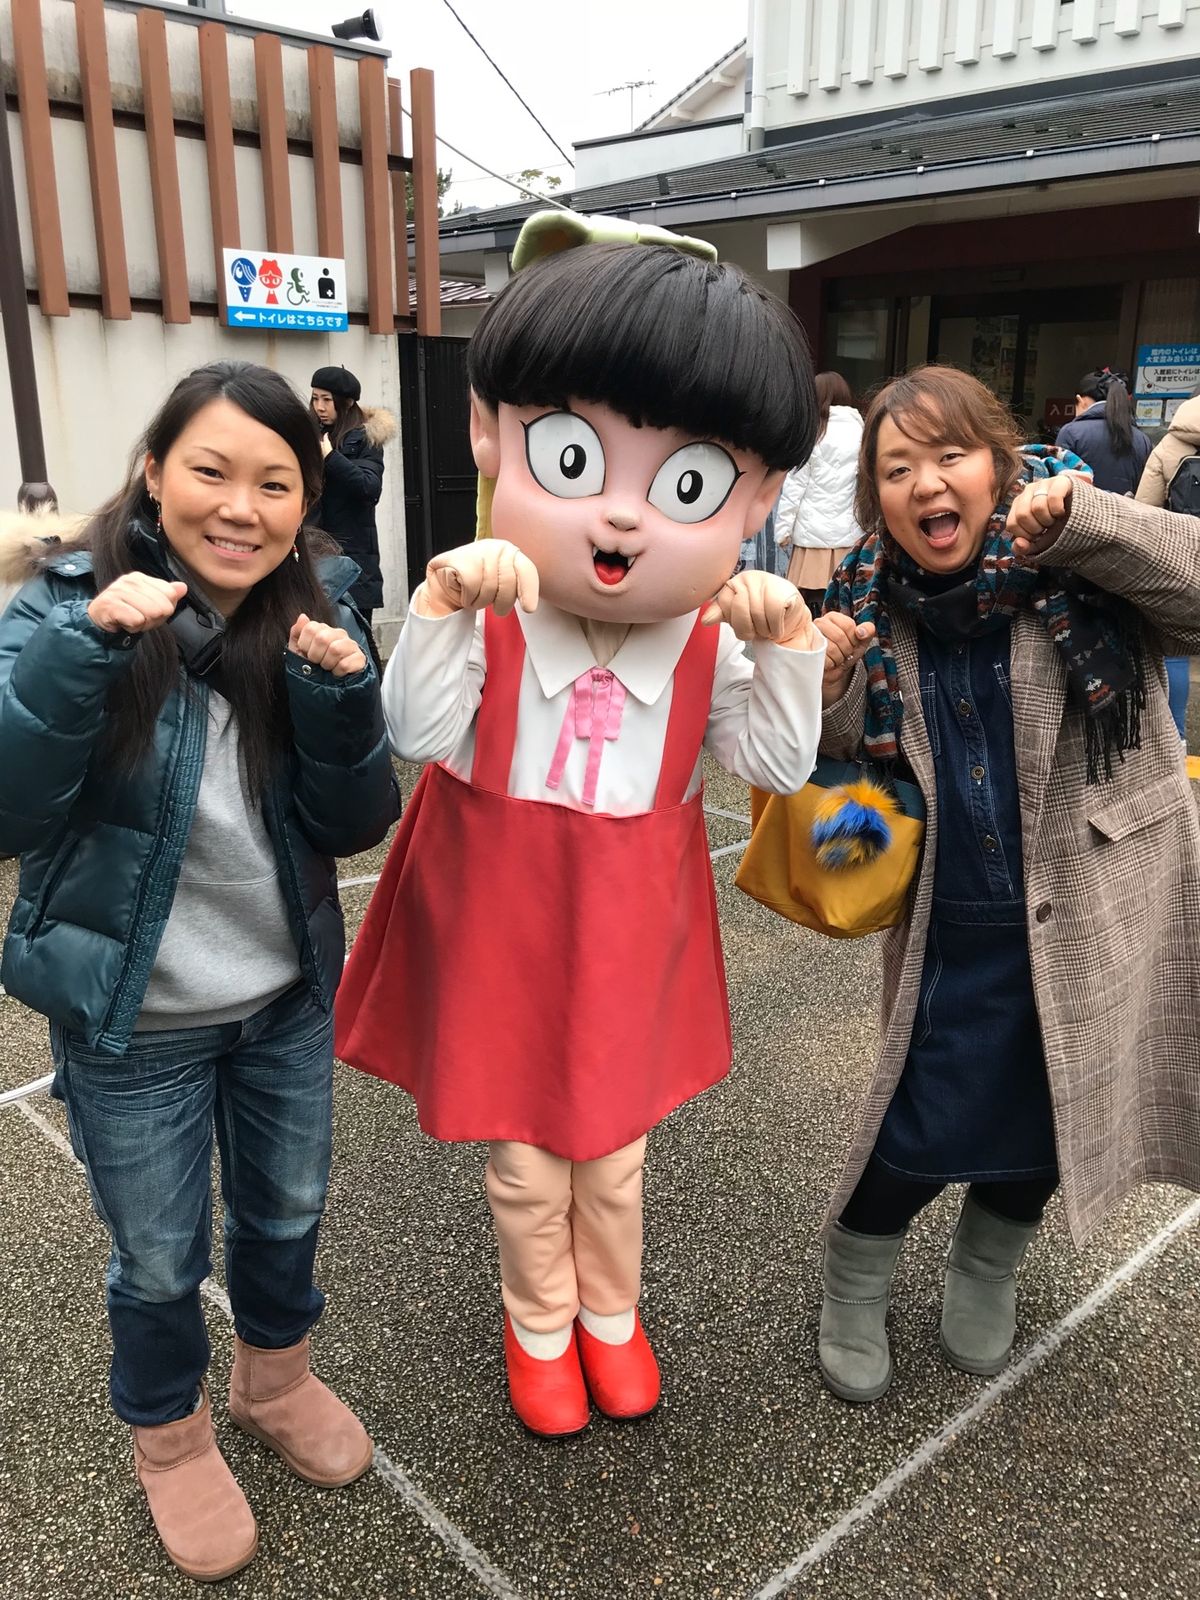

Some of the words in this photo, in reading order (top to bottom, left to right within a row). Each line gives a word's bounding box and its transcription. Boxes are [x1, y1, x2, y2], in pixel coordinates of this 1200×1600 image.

[259, 312, 343, 327] トイレはこちらです
[1050, 404, 1075, 416] 入口
